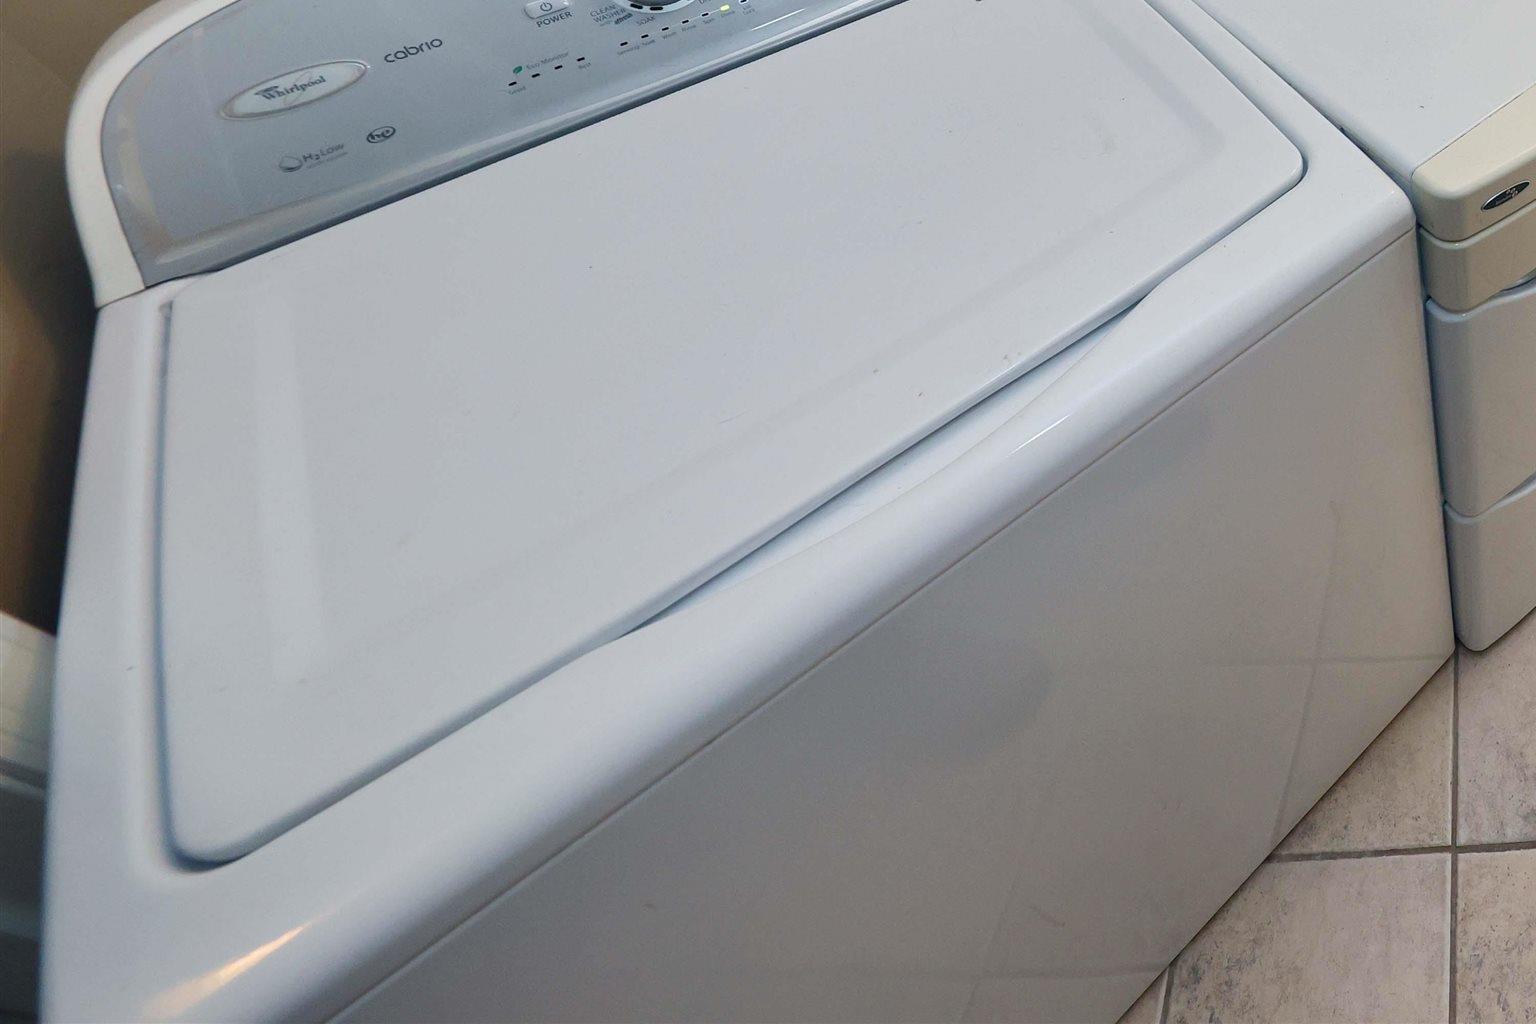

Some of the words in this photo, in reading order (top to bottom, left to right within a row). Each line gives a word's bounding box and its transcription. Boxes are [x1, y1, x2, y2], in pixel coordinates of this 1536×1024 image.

[590, 4, 617, 18] CLEAN
[593, 8, 627, 24] WASHER
[536, 12, 572, 28] POWER
[384, 38, 443, 64] cabrio
[257, 75, 326, 102] Whirlpool
